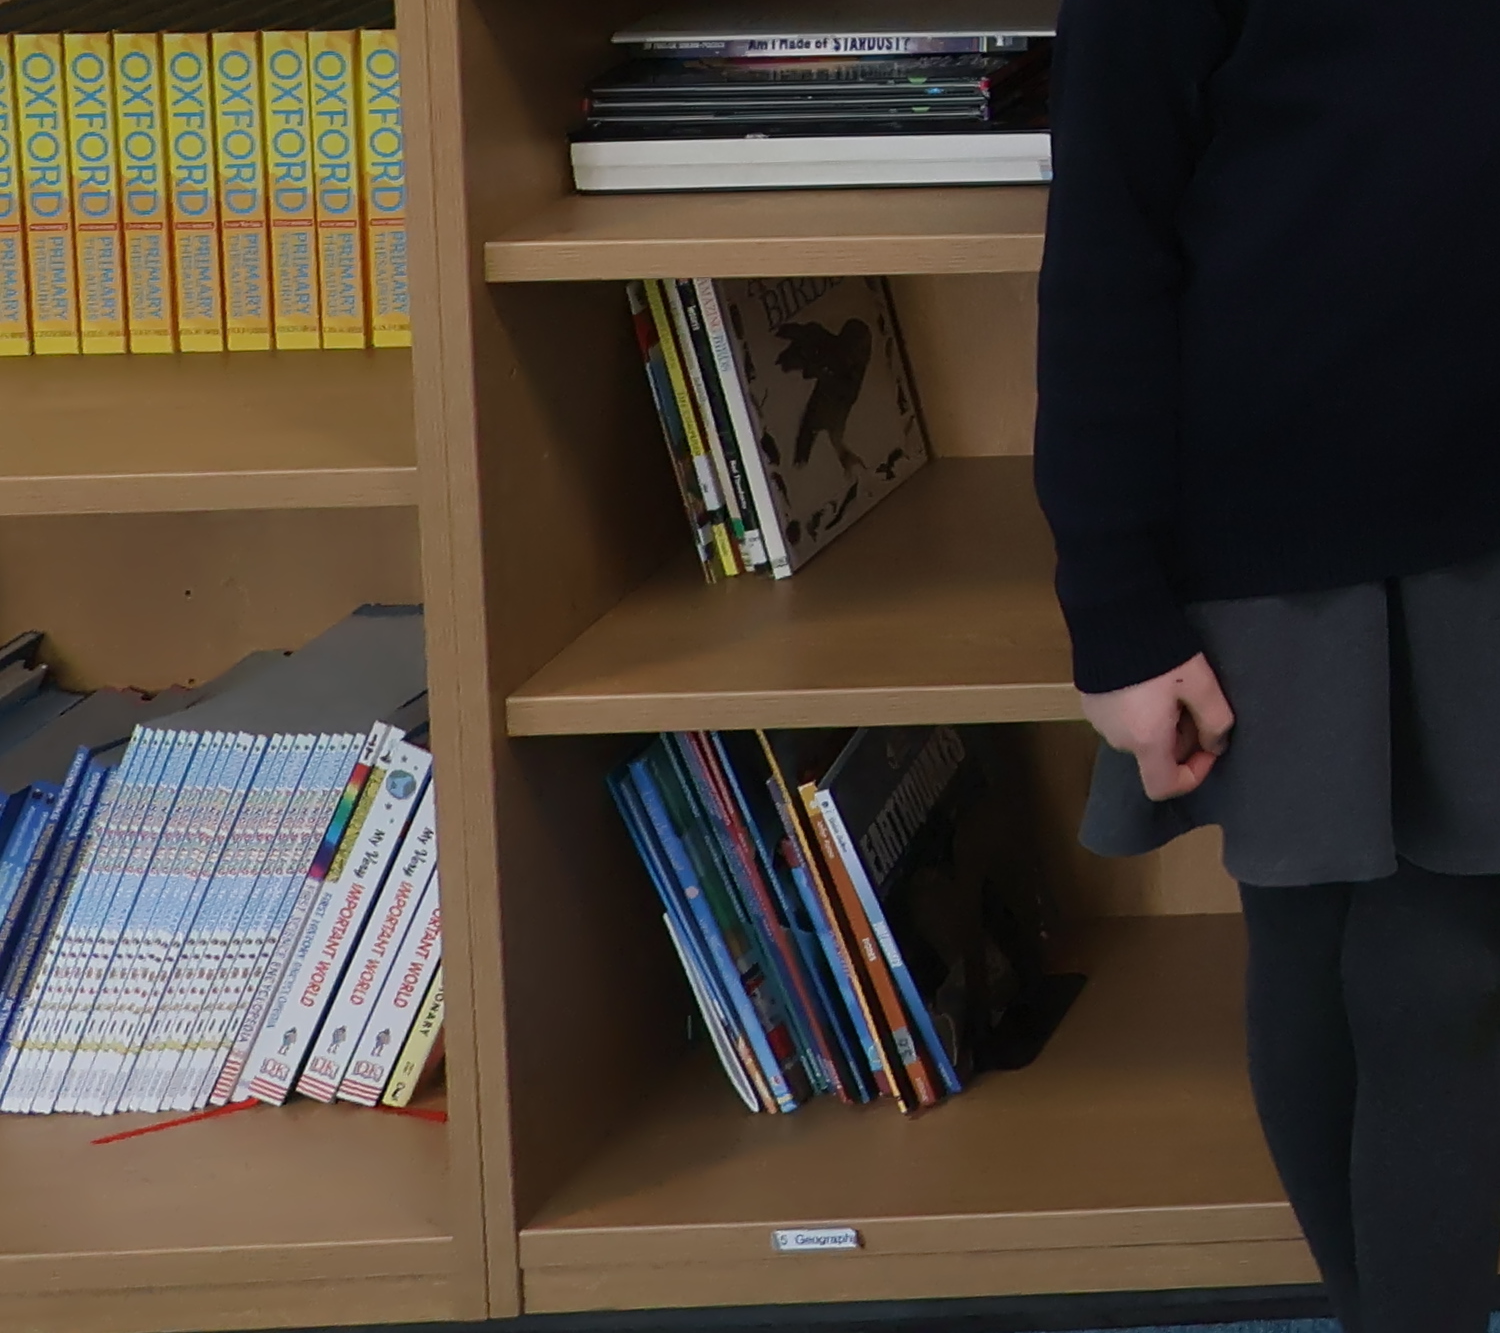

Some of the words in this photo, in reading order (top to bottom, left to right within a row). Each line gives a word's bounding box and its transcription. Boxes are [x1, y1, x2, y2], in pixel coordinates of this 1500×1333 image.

[815, 38, 828, 49] of
[22, 52, 62, 218] OXFORD
[71, 52, 114, 218] OXFORD
[120, 51, 161, 217] OXFORD
[170, 51, 209, 217] OXFORD
[218, 50, 257, 215] OXFORD
[269, 49, 308, 214] OXFORD
[1, 237, 18, 321] PRIMARY
[50, 236, 68, 321] PRIMARY
[98, 236, 116, 321] PRIMARY
[146, 235, 163, 321] PRIMARY
[195, 235, 213, 320] PRIMARY
[244, 234, 261, 318] PRIMARY
[353, 850, 380, 879] Very
[373, 828, 385, 844] My
[322, 882, 366, 961] IMPORTANT
[370, 882, 415, 960] IMPORTANT
[299, 958, 333, 1008] WORLD
[350, 958, 382, 1007] WORLD
[393, 957, 426, 1008] WORLD
